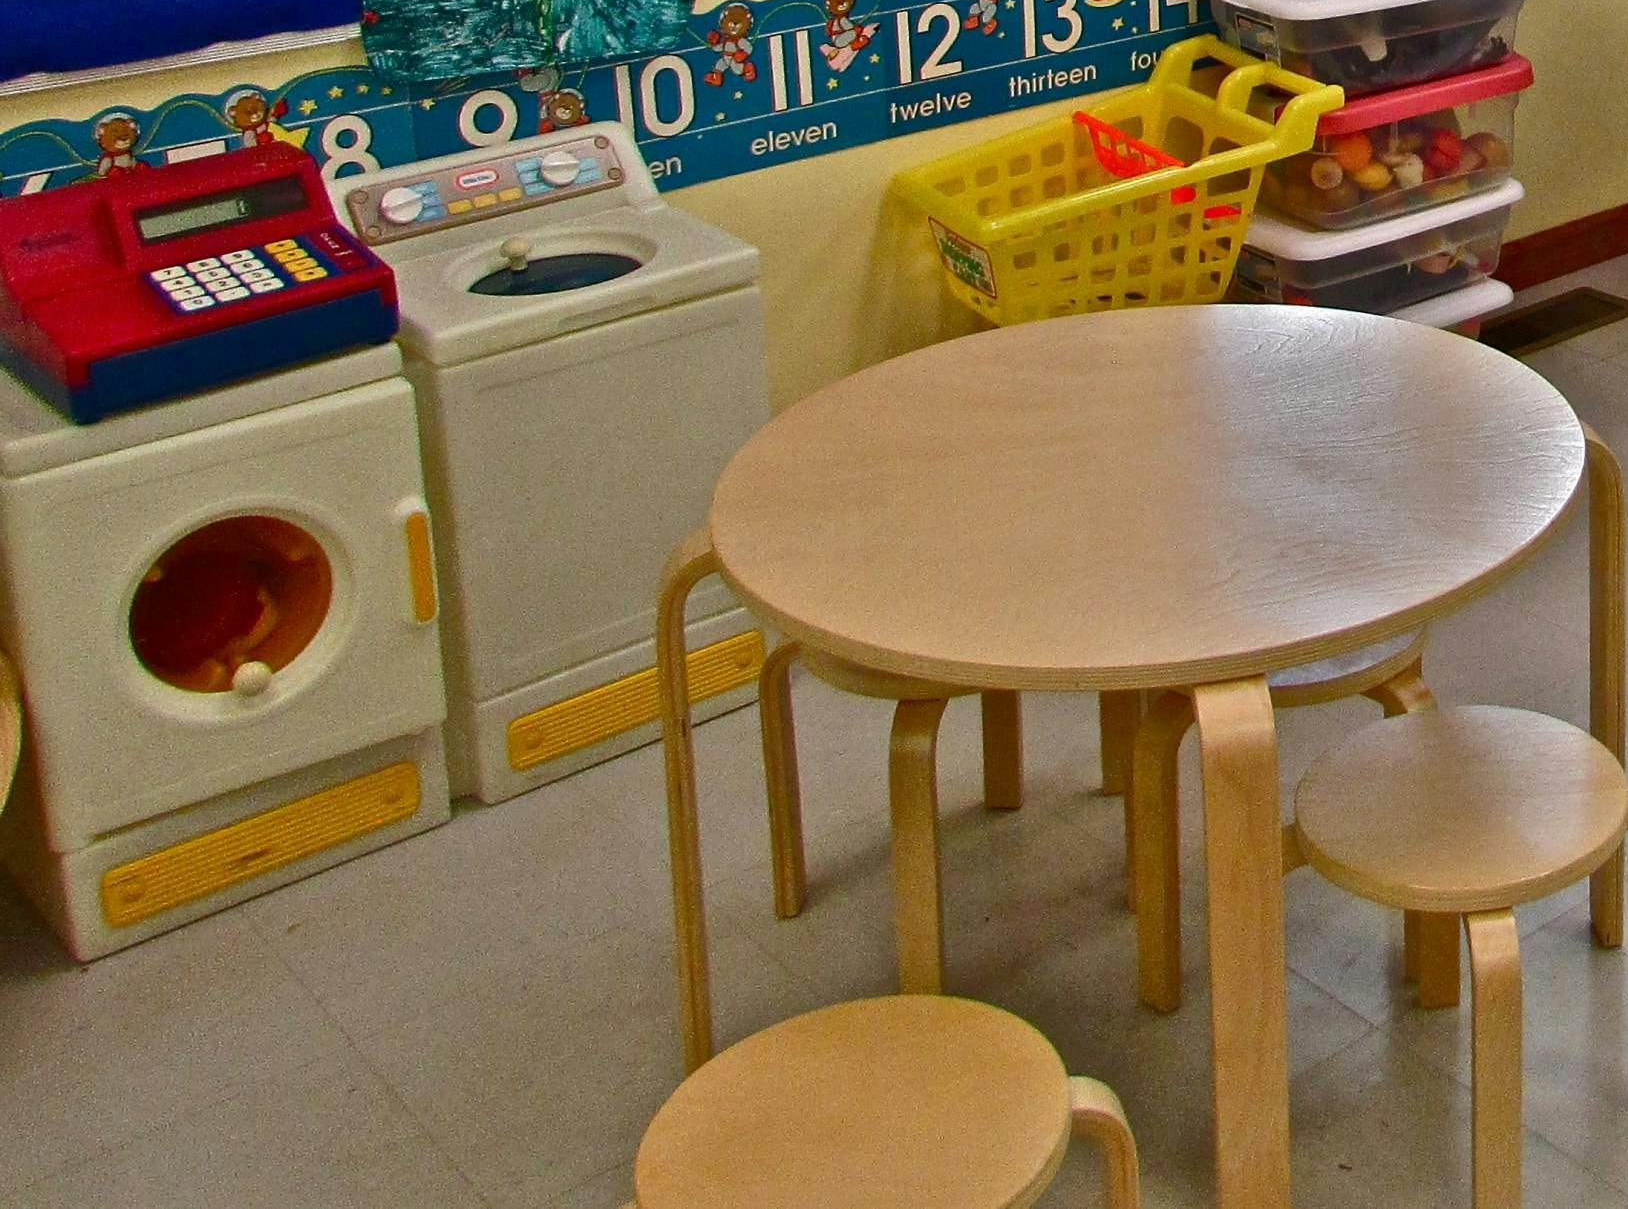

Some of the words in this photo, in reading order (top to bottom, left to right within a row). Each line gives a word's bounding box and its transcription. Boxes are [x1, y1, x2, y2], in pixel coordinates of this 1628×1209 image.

[768, 29, 814, 112] 11
[896, 2, 964, 86] 12
[614, 54, 695, 143] 10
[889, 89, 972, 123] twelve
[1008, 62, 1097, 98] thirteen
[320, 113, 384, 181] 8
[750, 118, 837, 156] eleven
[649, 153, 682, 180] en
